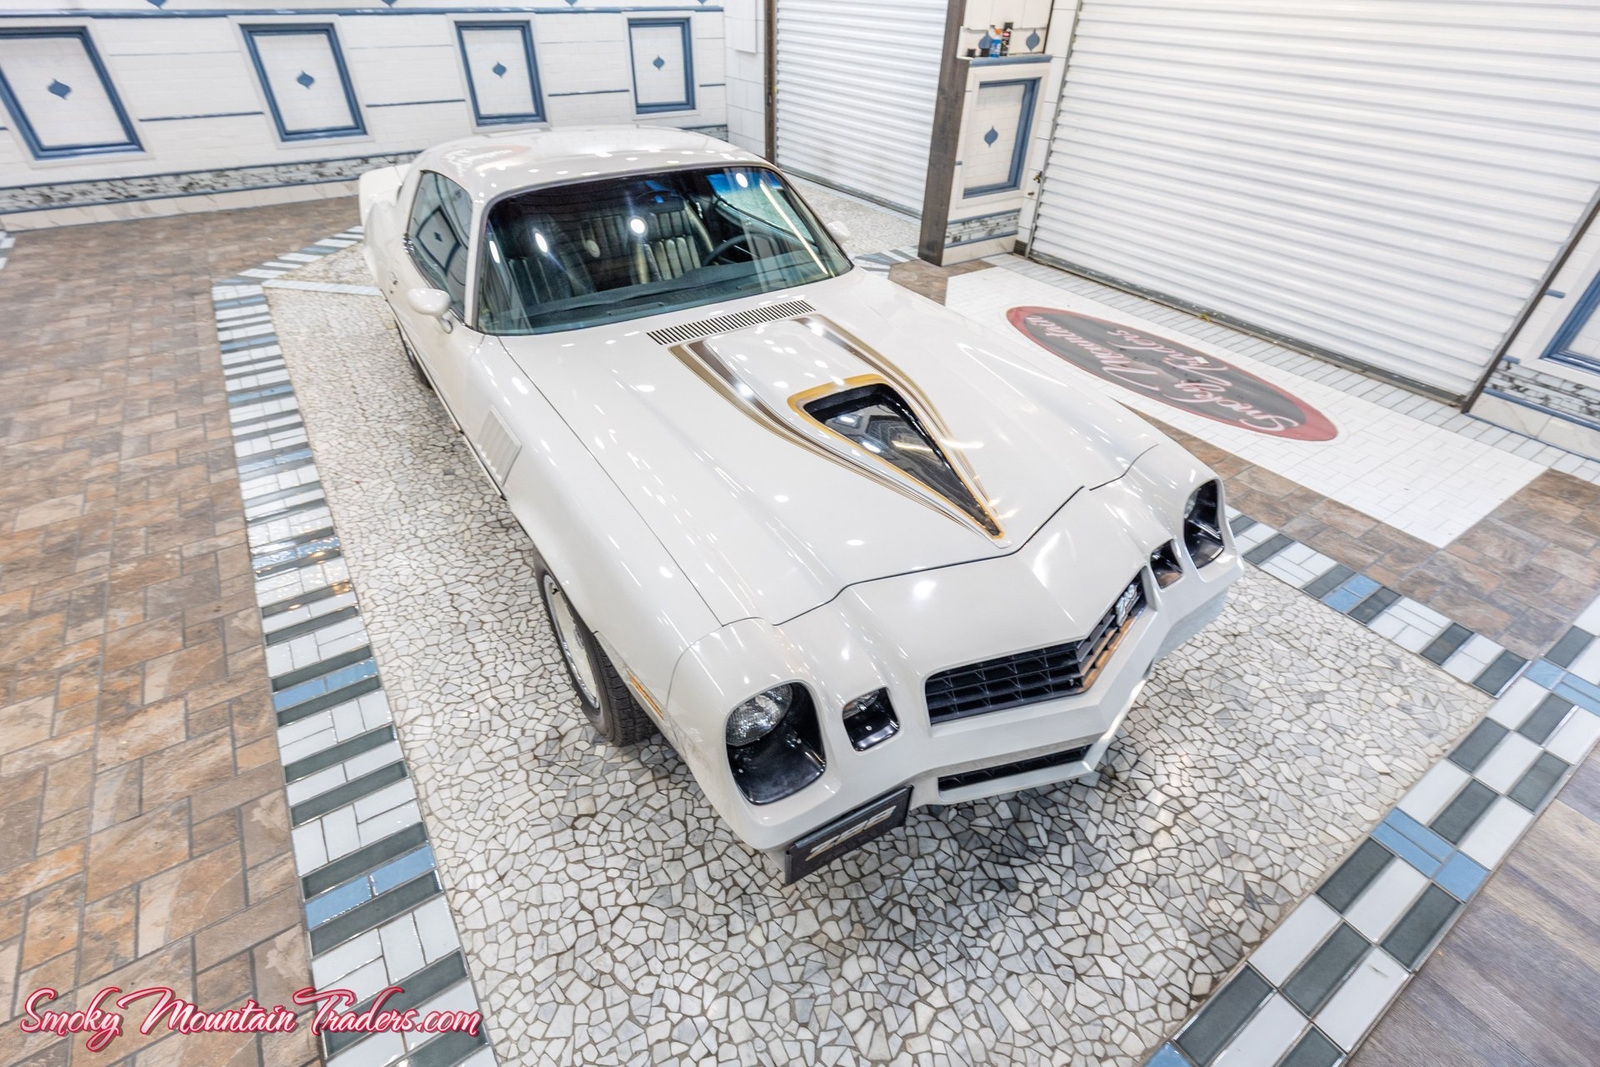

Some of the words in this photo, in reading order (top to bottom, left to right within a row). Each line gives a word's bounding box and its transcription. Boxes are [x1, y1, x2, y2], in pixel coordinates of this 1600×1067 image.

[1026, 314, 1161, 391] Mountain
[1107, 329, 1232, 387] Traders
[1163, 380, 1299, 432] Smoky
